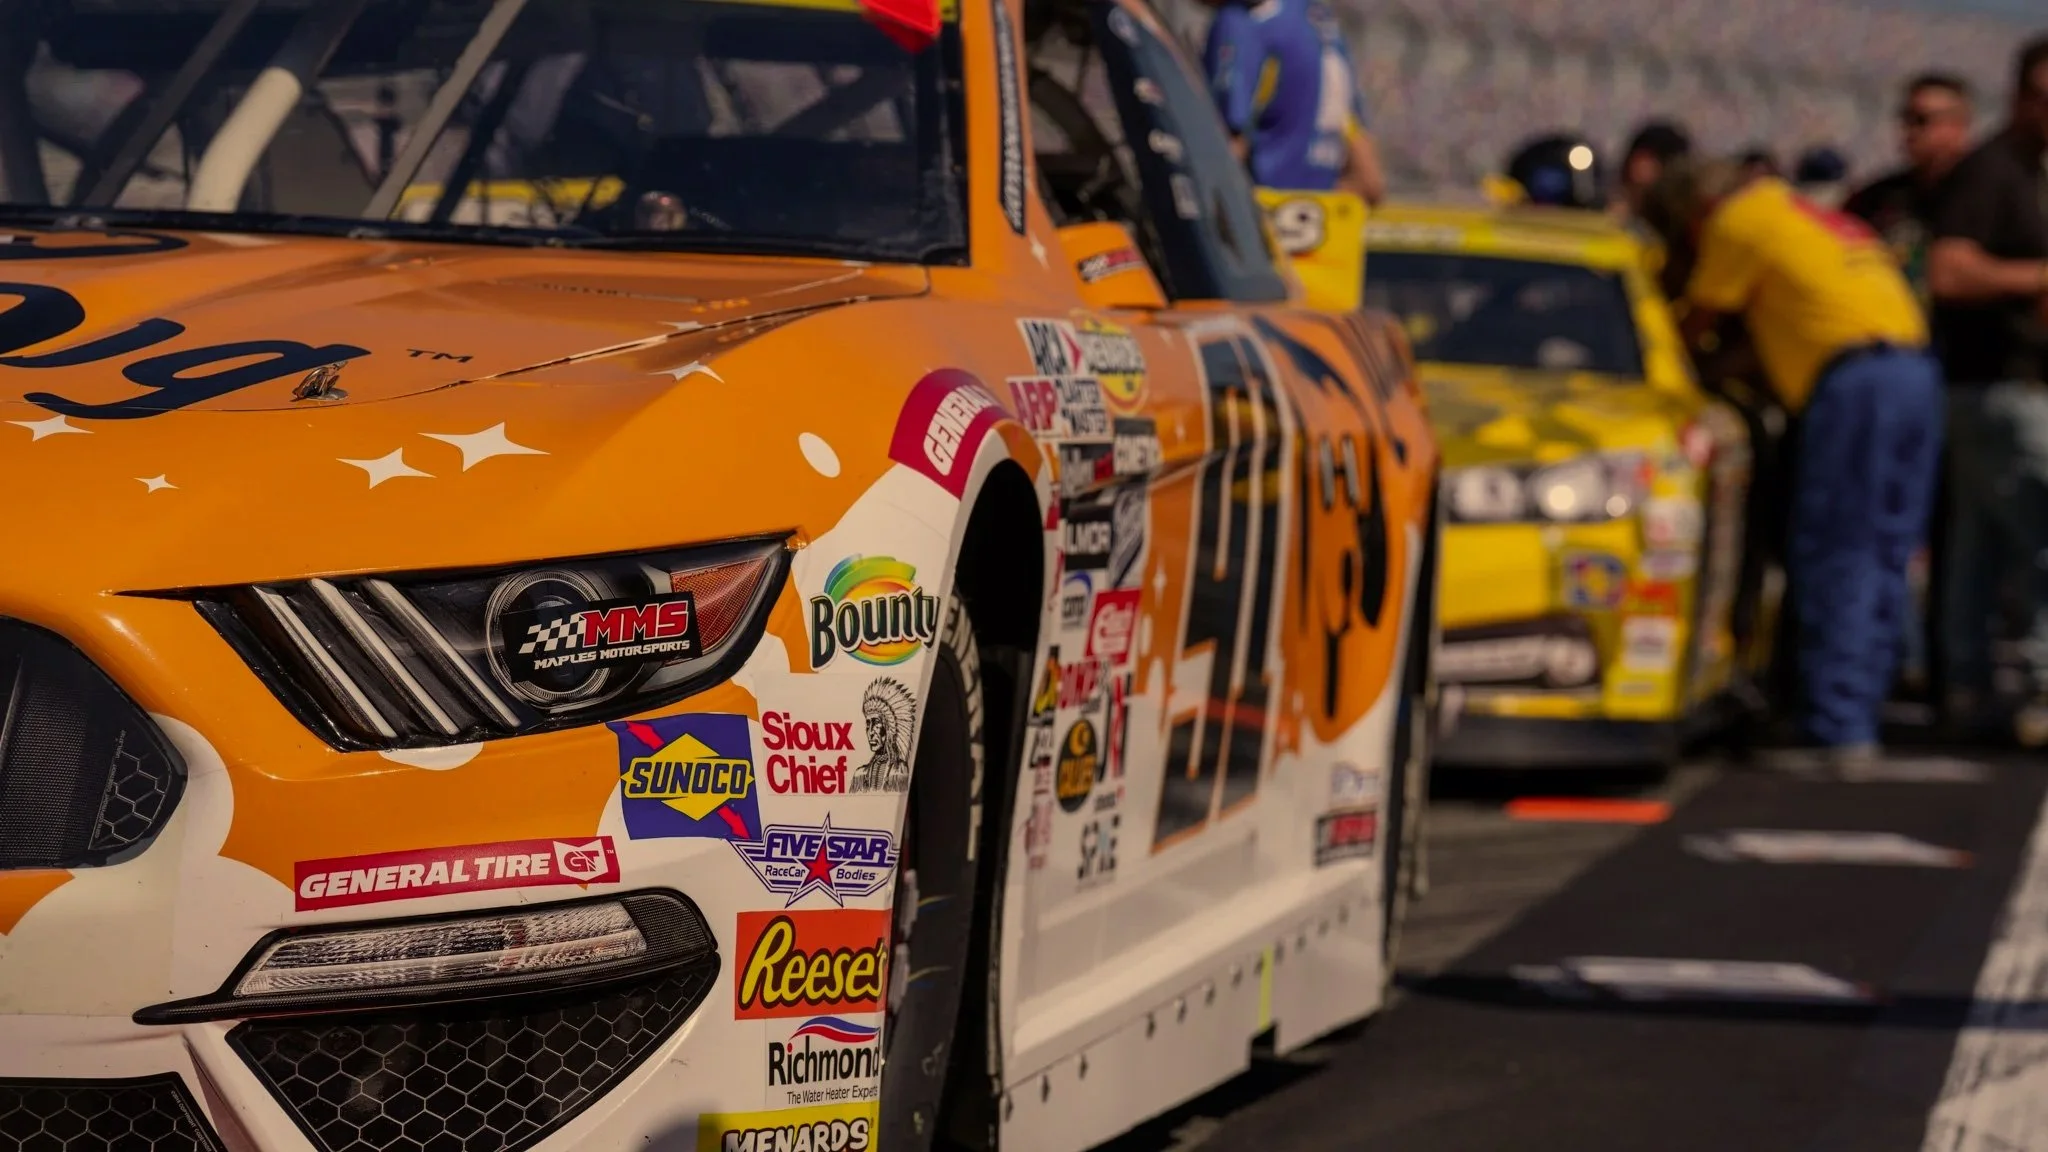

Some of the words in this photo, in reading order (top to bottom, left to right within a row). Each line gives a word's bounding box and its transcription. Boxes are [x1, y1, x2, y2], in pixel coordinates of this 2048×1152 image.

[406, 347, 474, 364] TM
[1008, 381, 1057, 431] ARP
[581, 600, 689, 648] MMS
[810, 586, 941, 672] Bounty
[534, 651, 597, 671] MAPLES
[599, 639, 690, 660] MOTORSPORTS
[761, 710, 855, 751] Sioux
[629, 761, 751, 795] SUNOCO
[766, 754, 848, 795] Chief
[766, 832, 824, 861] FIVE
[827, 834, 895, 867] STAR
[299, 860, 474, 899] GENERAL
[474, 852, 552, 879] TIRE
[765, 865, 806, 878] RaceCar
[836, 868, 876, 882] Bodies
[738, 914, 887, 1011] Reese's
[768, 1028, 881, 1086] Richmond
[787, 1090, 801, 1104] The
[803, 1088, 825, 1104] Water
[825, 1087, 851, 1101] Heater
[721, 1117, 870, 1152] MENARDS
